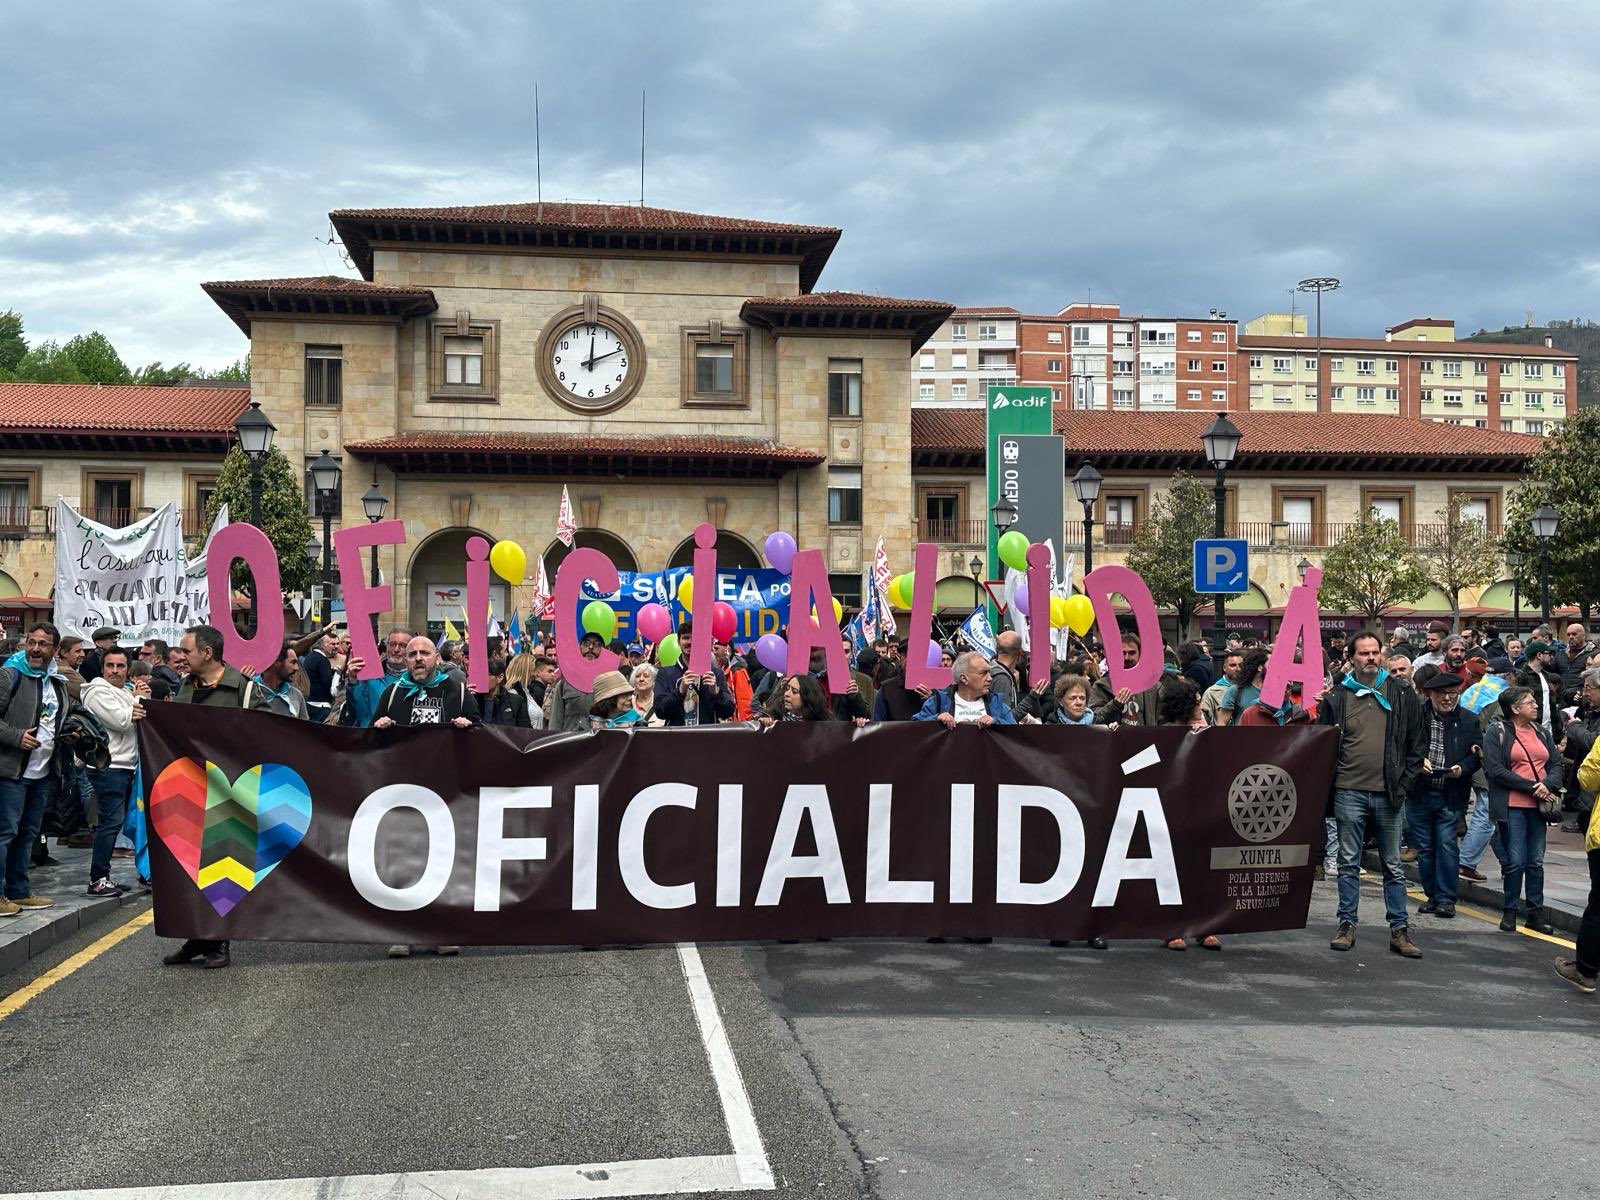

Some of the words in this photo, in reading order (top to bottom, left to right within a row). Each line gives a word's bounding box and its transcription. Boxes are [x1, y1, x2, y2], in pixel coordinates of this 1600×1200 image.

[572, 330, 579, 339] 11
[586, 327, 596, 336] 12
[560, 341, 569, 350] 10
[616, 341, 624, 351] 2
[555, 356, 562, 365] 9
[620, 358, 627, 367] 3
[559, 371, 566, 381] 8
[615, 374, 622, 382] 4
[571, 382, 577, 392] 7
[605, 384, 611, 394] 5
[588, 388, 594, 397] 6
[1012, 396, 1047, 407] adif
[1205, 547, 1236, 586] P
[348, 744, 1182, 911] OFICIALIDÁ
[1239, 849, 1282, 865] XUNTA
[1229, 872, 1250, 884] POLA
[1254, 872, 1290, 883] DEFENSA
[1227, 885, 1238, 897] DE
[1241, 885, 1253, 896] LA
[1257, 884, 1289, 896] LLINGUA
[1236, 897, 1280, 910] ASTURIANA
